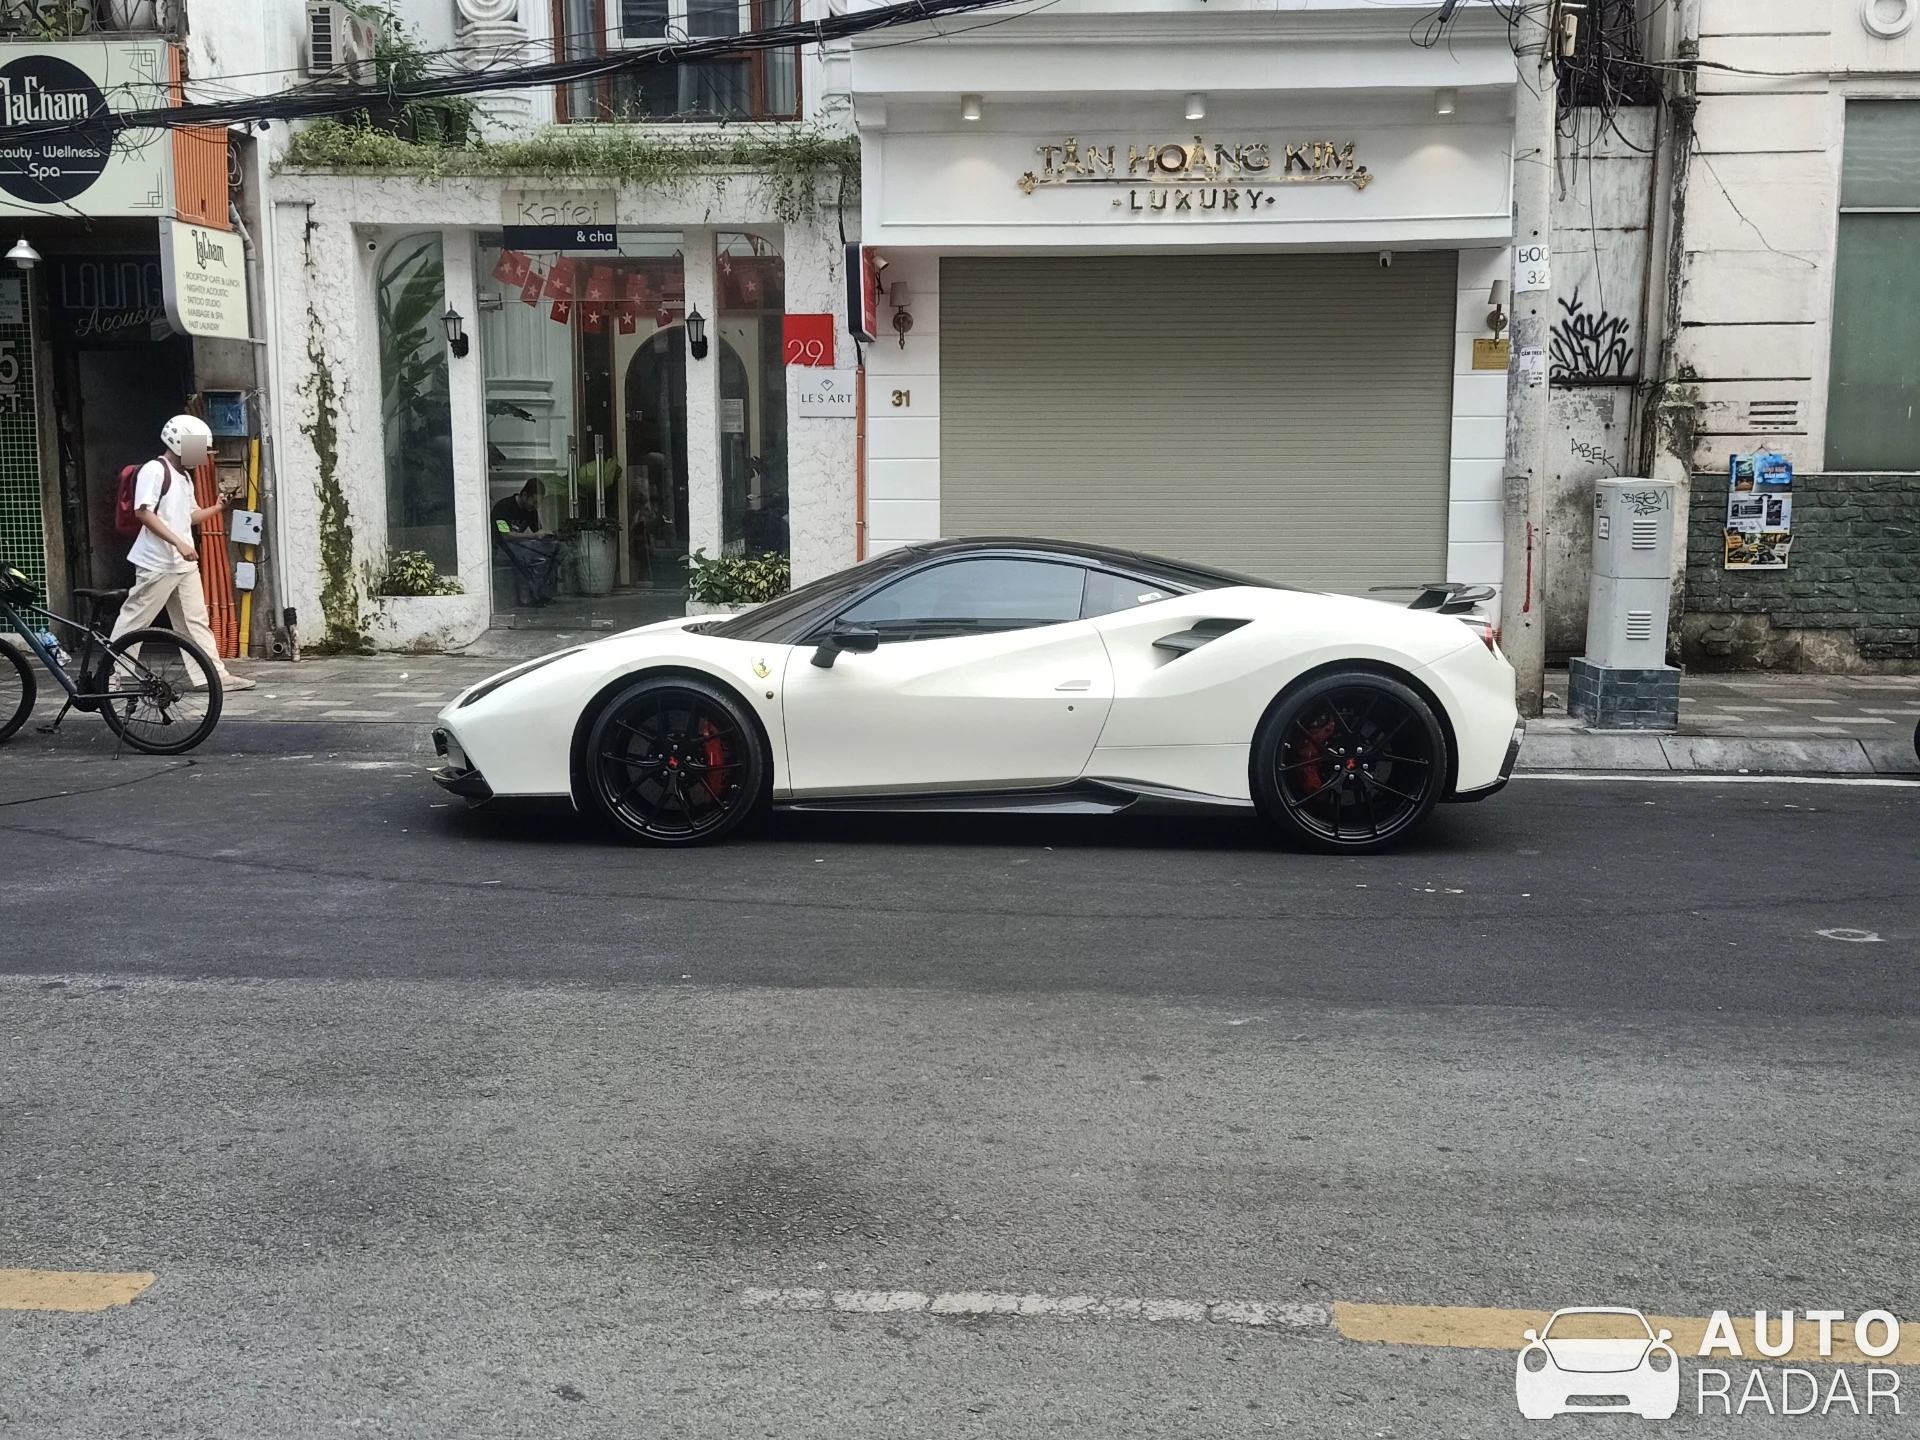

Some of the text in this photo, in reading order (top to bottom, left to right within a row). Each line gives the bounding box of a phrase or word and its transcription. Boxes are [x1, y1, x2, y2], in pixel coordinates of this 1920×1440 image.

[43, 146, 100, 158] Wellness
[1285, 141, 1354, 171] KIM
[29, 163, 60, 181] Spa
[1129, 188, 1263, 210] LUXURY
[517, 200, 600, 226] Kafei
[576, 230, 613, 242] & cha
[186, 271, 208, 282] ROOFTOP
[1527, 270, 1545, 285] 32
[206, 287, 229, 297] ACOUSTIC
[187, 296, 221, 308] TATTOO STUDIO
[188, 308, 210, 318] MASSAGE
[787, 339, 824, 367] 29
[829, 393, 853, 403] ART
[891, 389, 910, 407] 31
